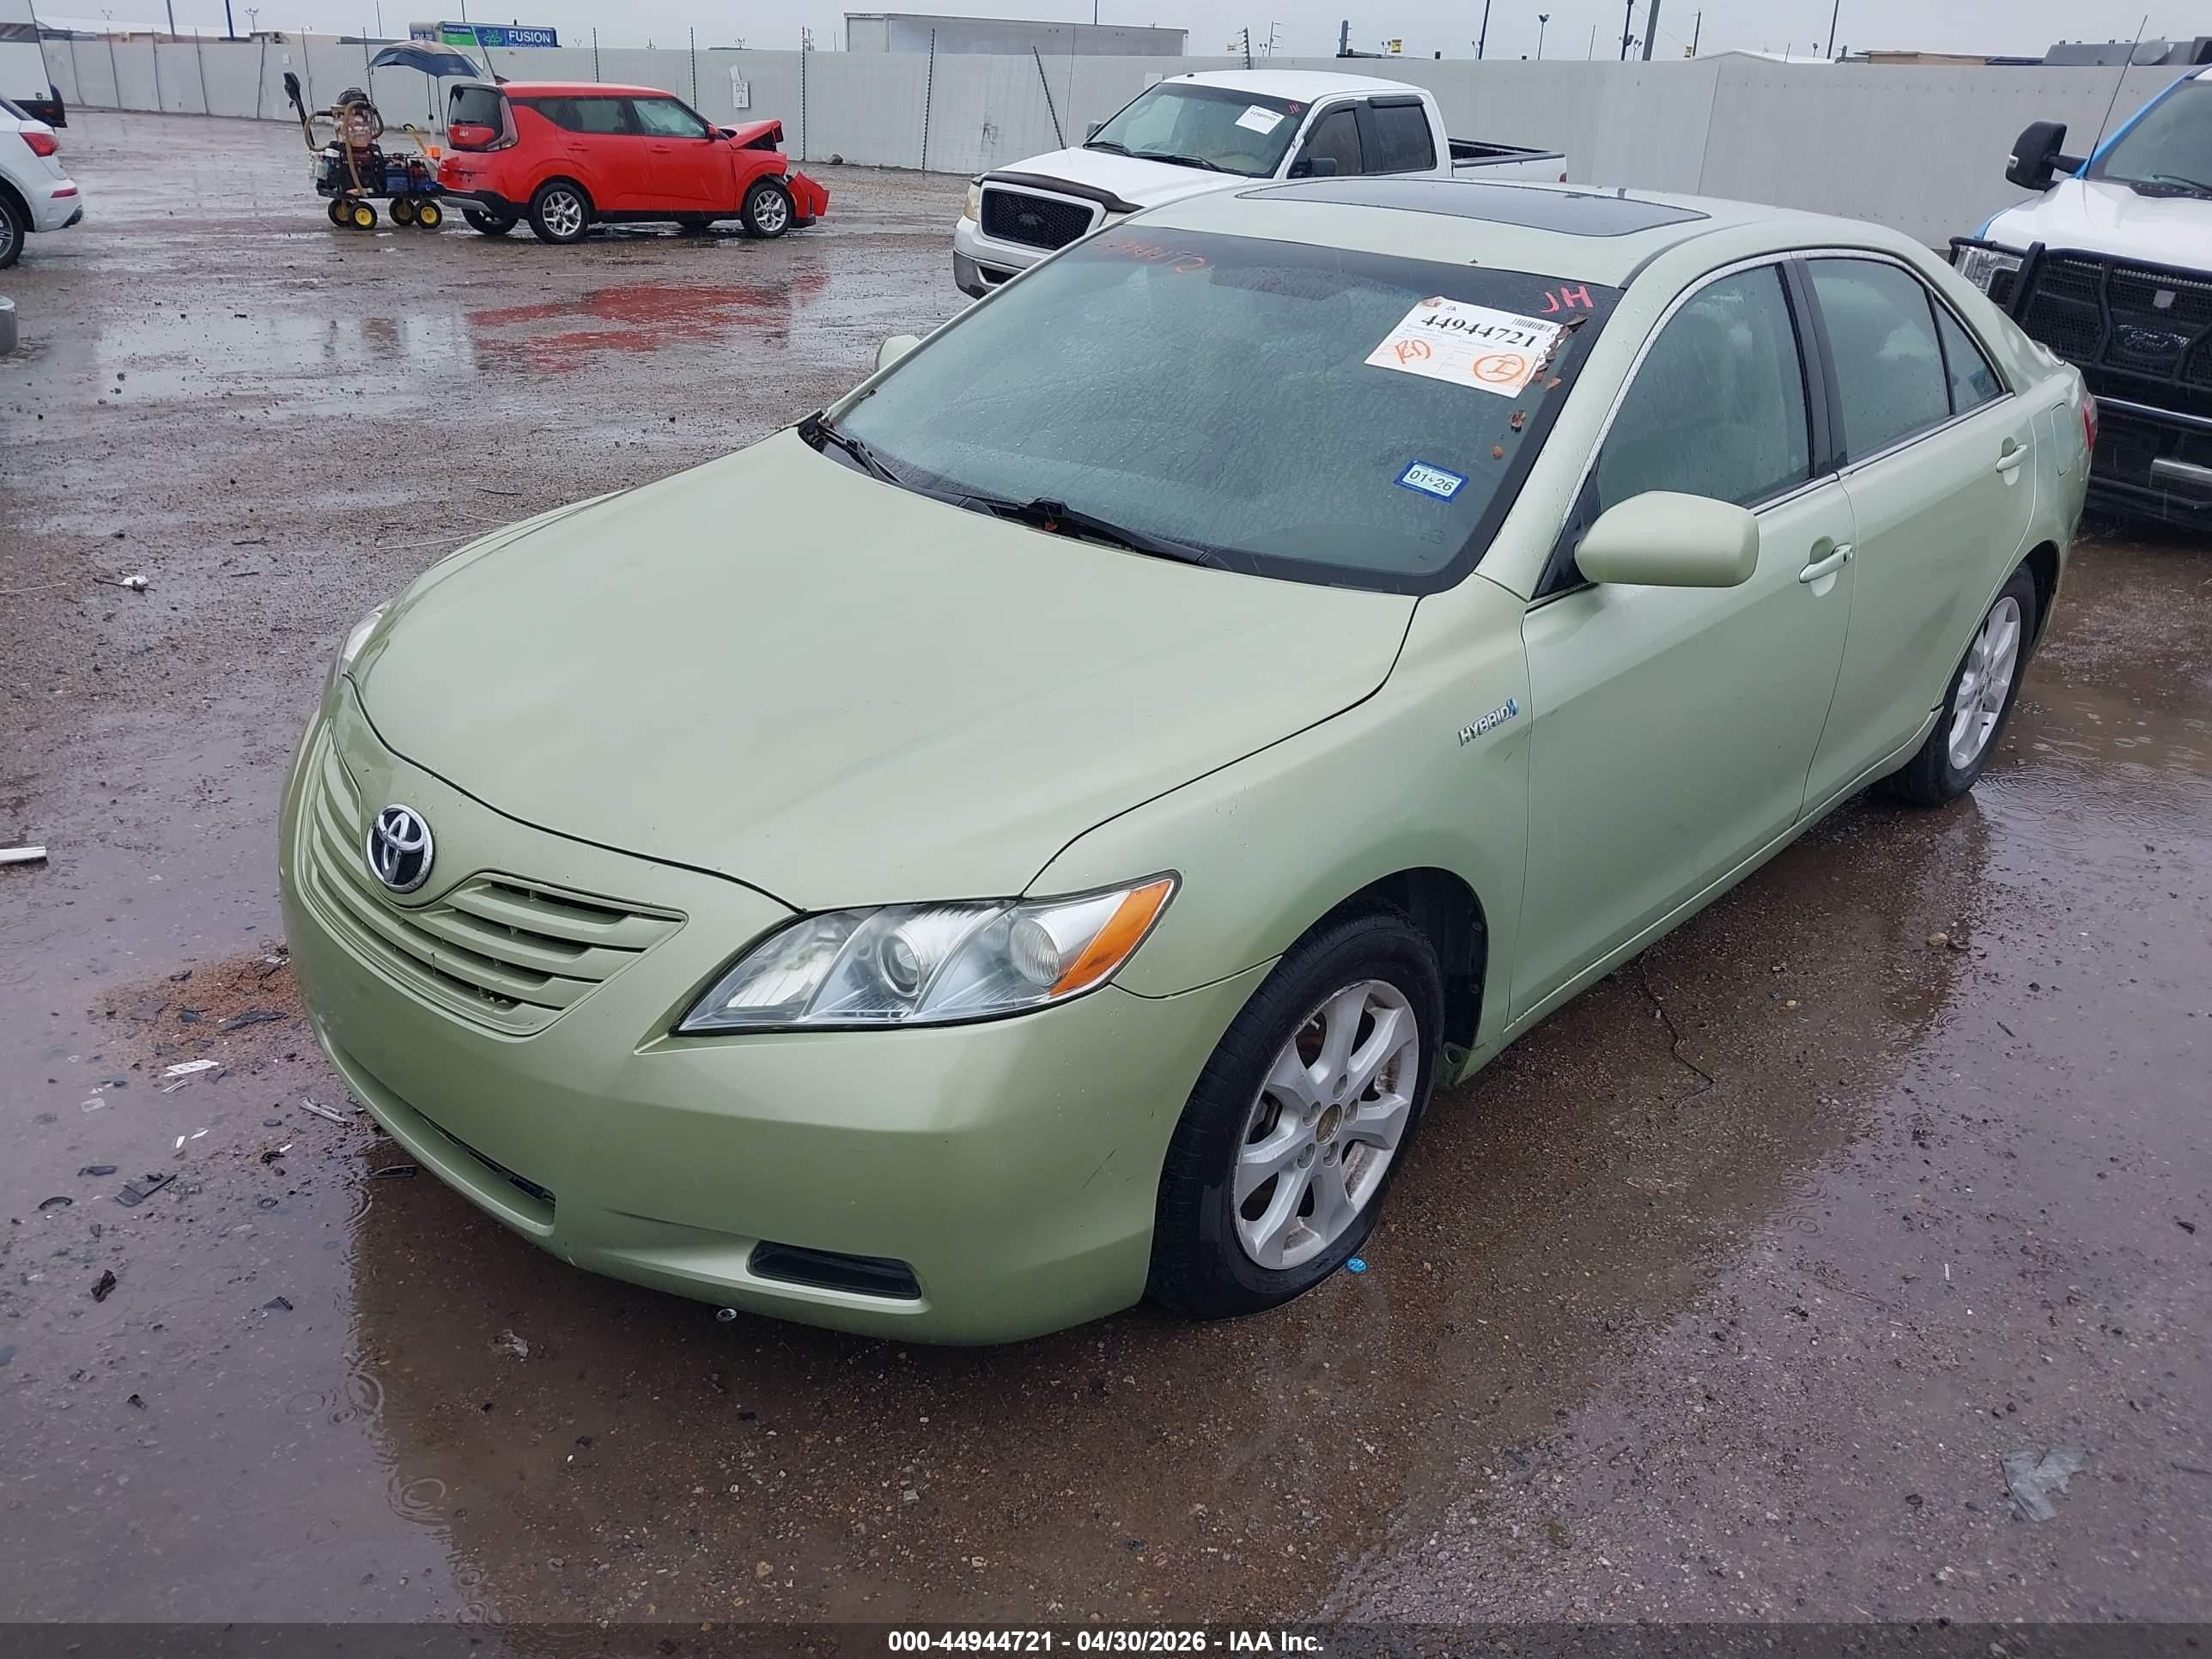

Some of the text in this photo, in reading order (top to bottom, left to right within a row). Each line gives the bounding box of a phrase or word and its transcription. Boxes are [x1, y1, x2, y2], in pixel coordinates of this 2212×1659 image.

[508, 30, 550, 43] FUSION
[1540, 285, 1594, 313] JH
[1421, 314, 1537, 348] 44944721
[1458, 705, 1510, 746] HYBRID
